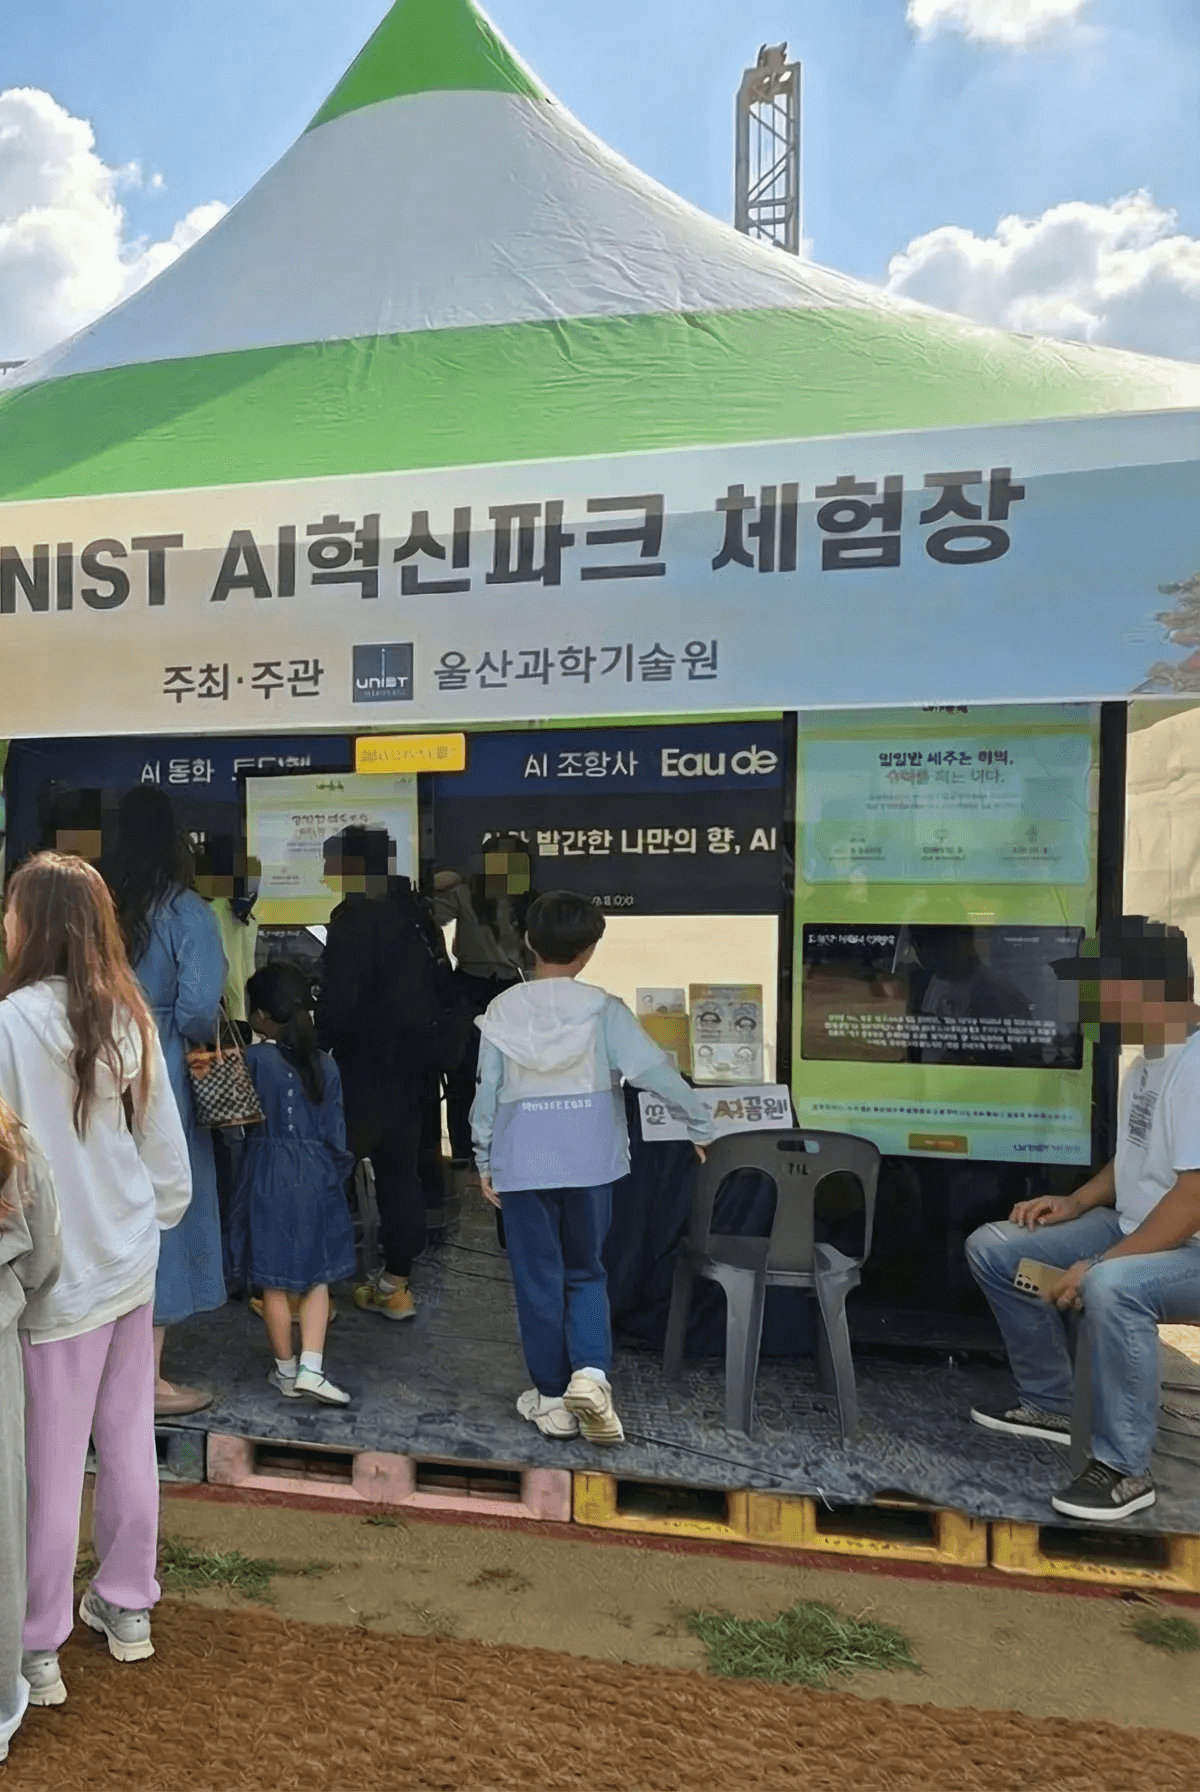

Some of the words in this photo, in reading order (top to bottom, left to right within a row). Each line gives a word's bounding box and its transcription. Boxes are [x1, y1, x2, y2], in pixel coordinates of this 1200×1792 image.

[209, 493, 666, 603] AI혁신파크
[710, 466, 1026, 574] 체험장
[162, 657, 324, 704] 주최·주관
[433, 638, 718, 692] 울산과학기술원
[525, 753, 547, 778] AI
[557, 750, 639, 777] 조향사
[661, 748, 726, 777] Eau
[731, 745, 779, 776] de
[749, 828, 777, 851] AI
